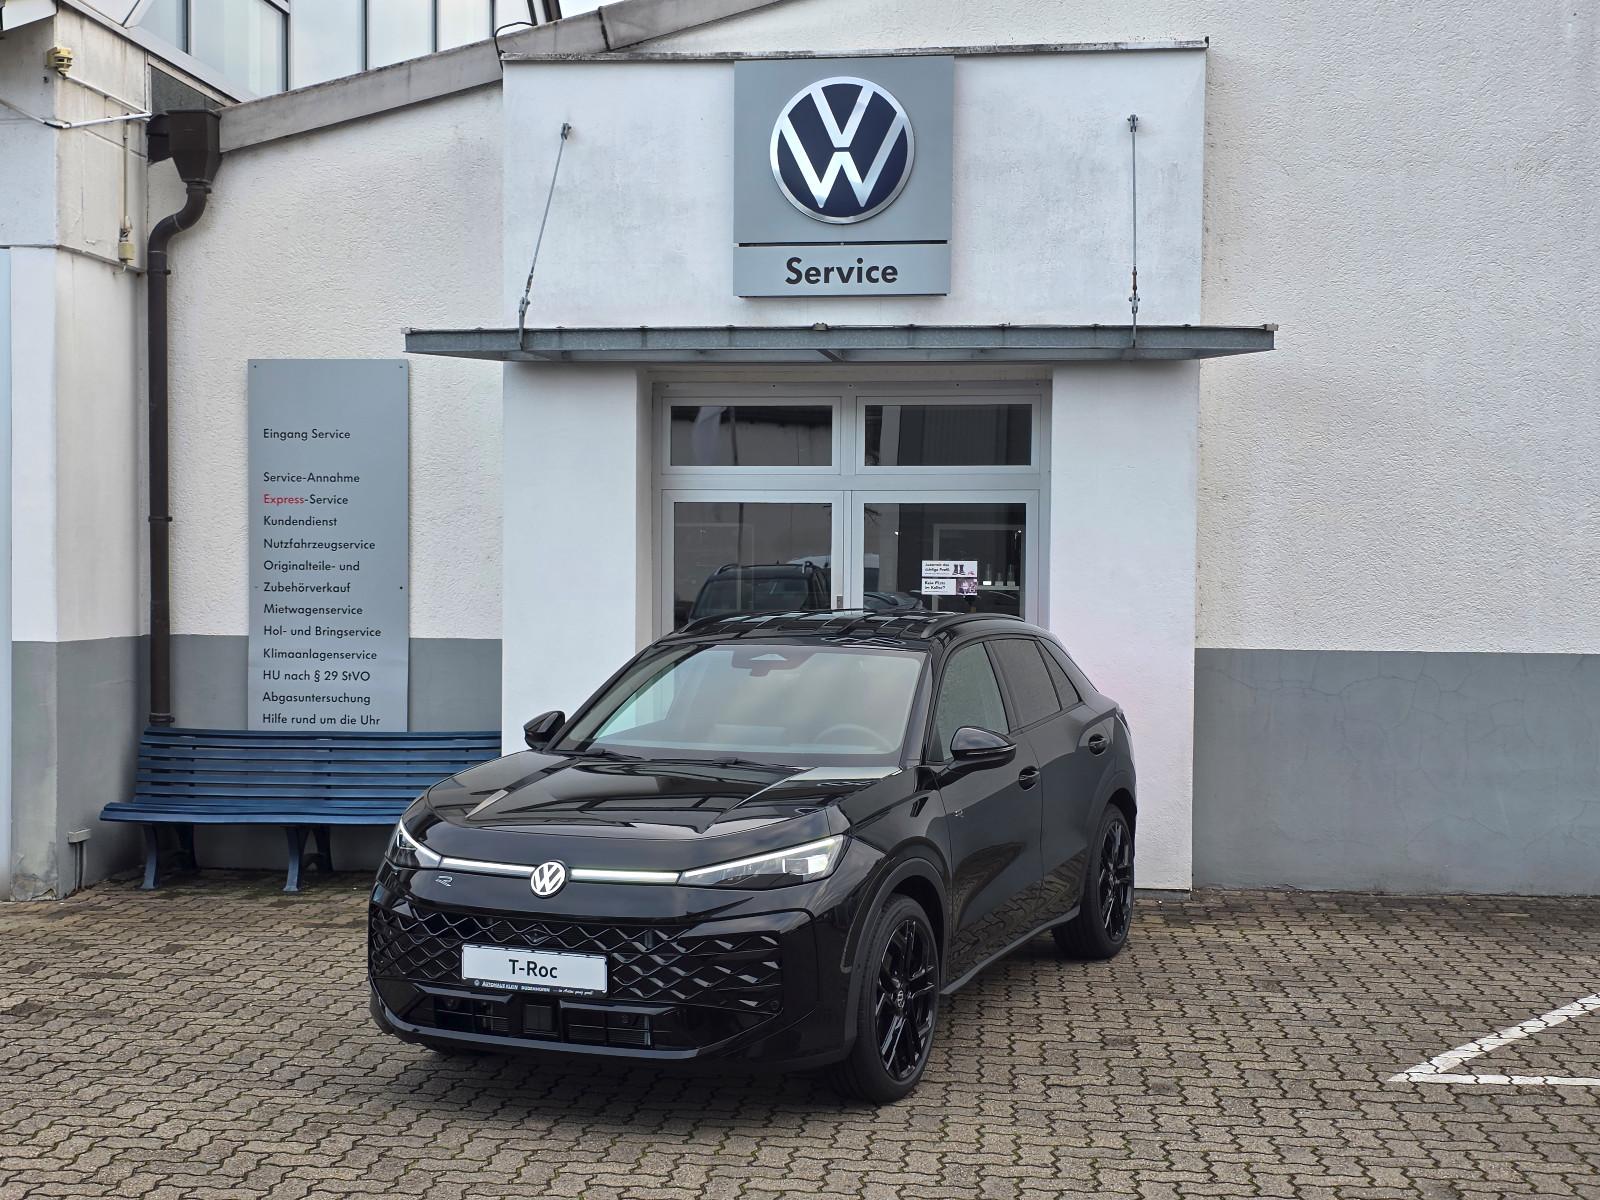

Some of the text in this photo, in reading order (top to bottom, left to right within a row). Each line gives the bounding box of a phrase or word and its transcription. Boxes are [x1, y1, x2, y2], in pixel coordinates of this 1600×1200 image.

[770, 76, 915, 225] VW
[785, 256, 899, 285] Service
[263, 428, 351, 441] Eingang Service
[263, 472, 361, 483] Service-Annahme
[263, 493, 349, 506] Express-Service
[263, 515, 338, 526] Kundendienst
[263, 538, 376, 551] Nutzfahrzeugservice
[263, 560, 360, 573] Originalteile- und
[263, 581, 352, 593] Zubehörverkauf
[263, 603, 364, 616] Mietwagenservice
[263, 625, 382, 639] Hol- und Bringservice
[263, 648, 378, 661] Klimaanlagenservice
[263, 670, 371, 682] HU nach § 29 StVO
[262, 691, 371, 705] Abgasuntersuchung
[262, 713, 381, 725] Hilfe rund um die Uhr
[530, 861, 566, 896] VW
[508, 958, 558, 979] T-Roc
